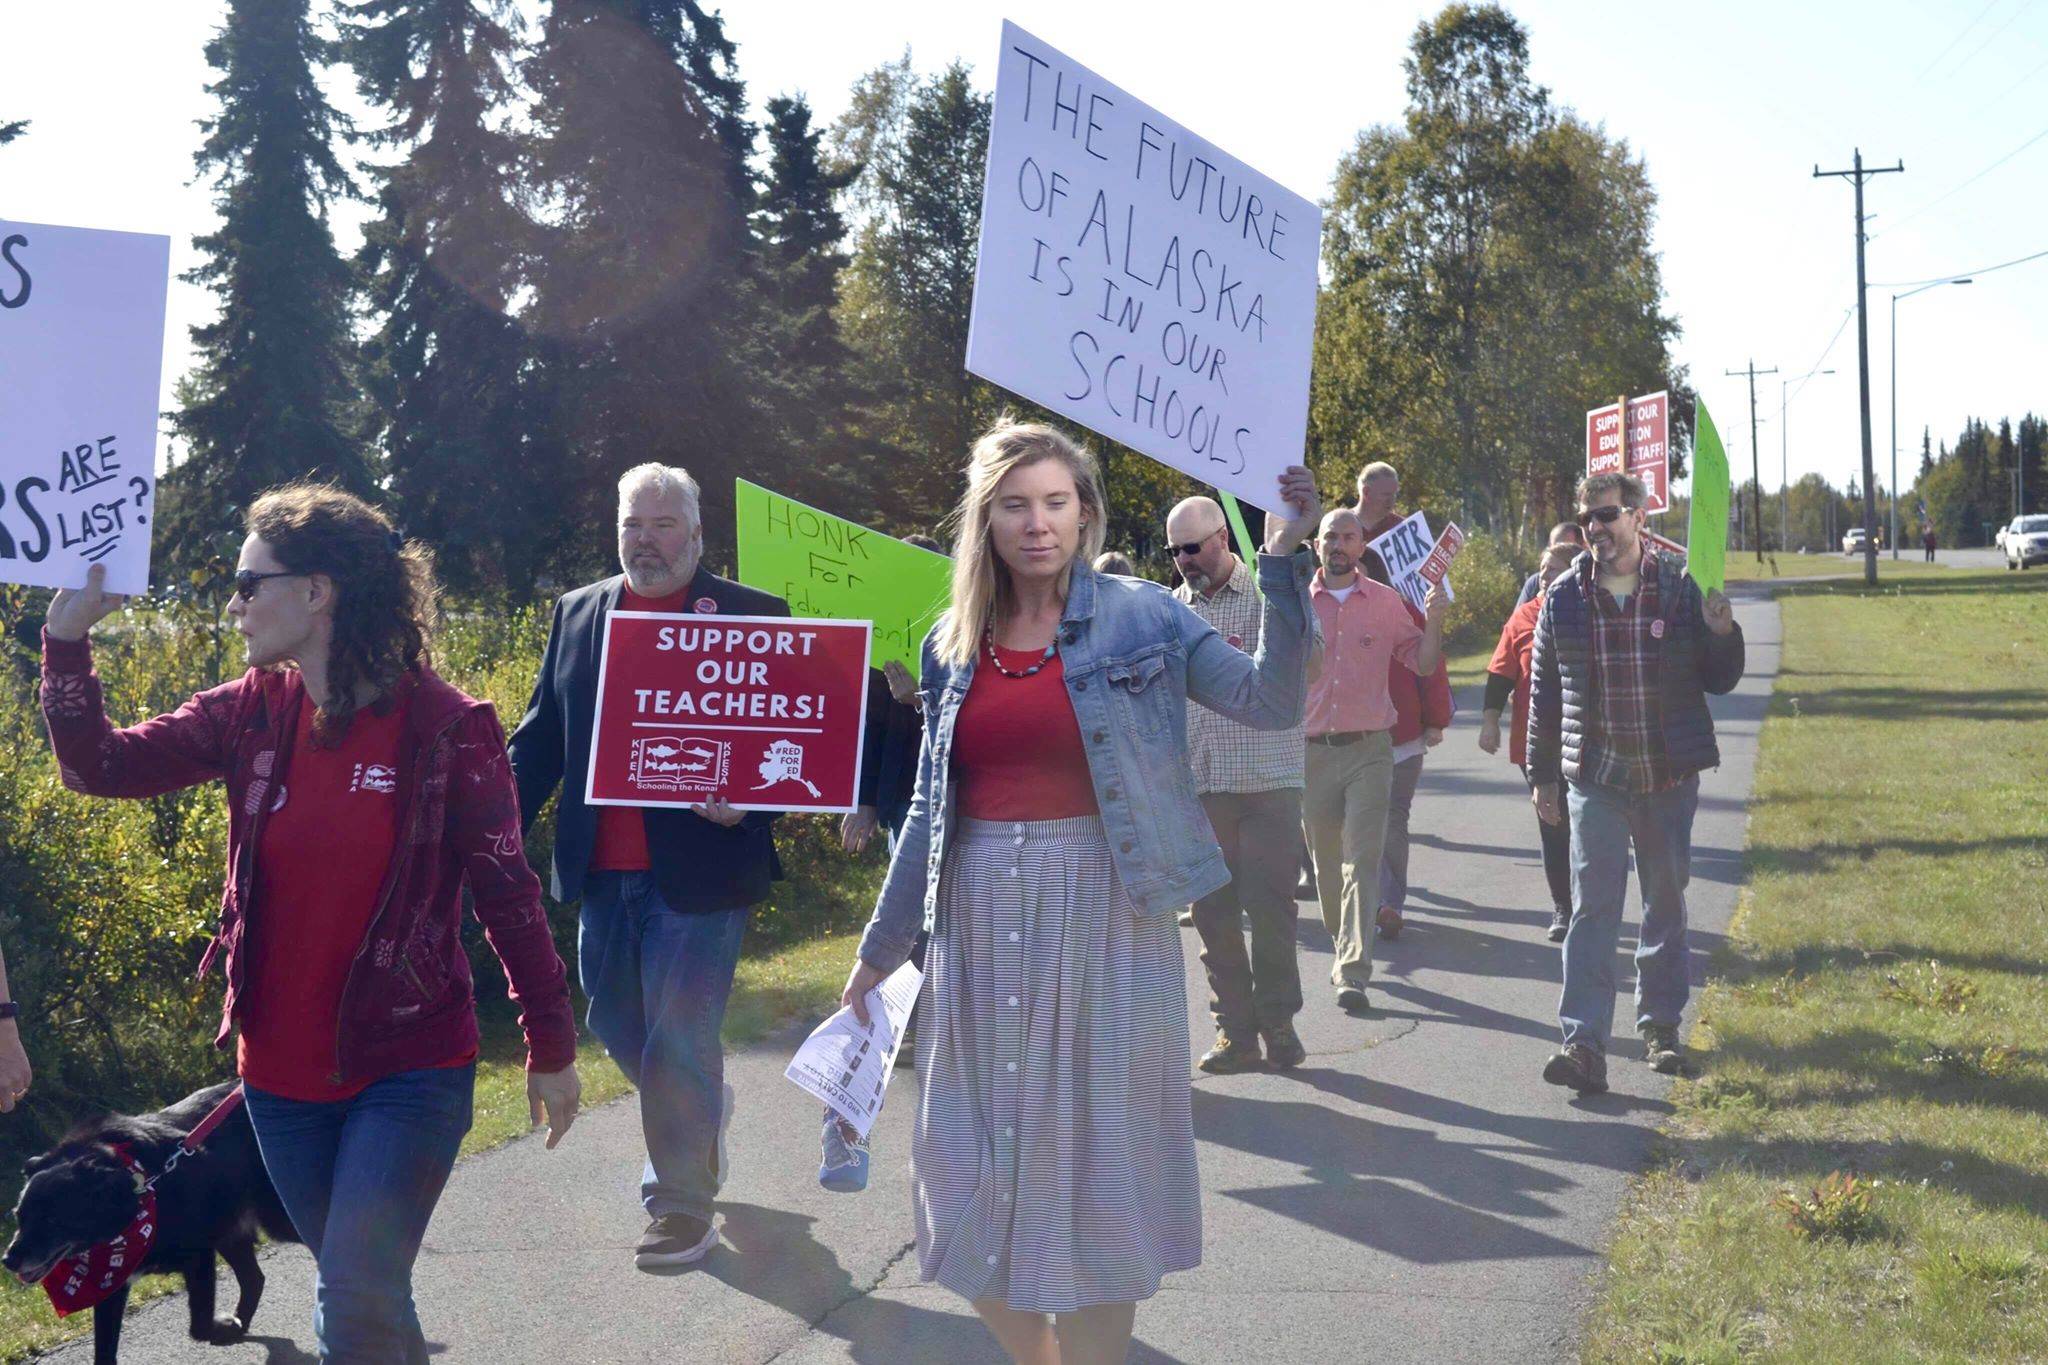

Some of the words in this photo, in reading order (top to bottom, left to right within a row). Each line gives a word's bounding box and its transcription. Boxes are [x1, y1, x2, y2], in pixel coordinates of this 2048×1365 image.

[1013, 46, 1114, 160] THE
[1137, 122, 1289, 261] FUTURE
[1018, 157, 1070, 218] OF
[1078, 189, 1268, 342] ALASKA
[1029, 238, 1074, 296] IS
[1097, 278, 1143, 333] IN
[1162, 321, 1229, 396] OUR
[1065, 331, 1251, 475] SCHOOLS
[1637, 404, 1658, 421] OUR
[58, 435, 122, 491] ARE
[1633, 441, 1664, 461] STAFF!
[57, 476, 150, 549] LAST?
[768, 496, 869, 560] HONK
[1380, 520, 1432, 576] FAIR
[809, 552, 864, 588] For
[656, 626, 817, 656] SUPPORT
[696, 660, 769, 686] OUR
[634, 689, 825, 719] TEACHERS!
[628, 739, 640, 782] KPEA
[775, 747, 800, 755] #RED
[780, 756, 799, 765] FOR
[636, 782, 677, 792] Schooling
[679, 783, 693, 791] the
[694, 784, 718, 792] Kenai
[787, 766, 798, 775] ED
